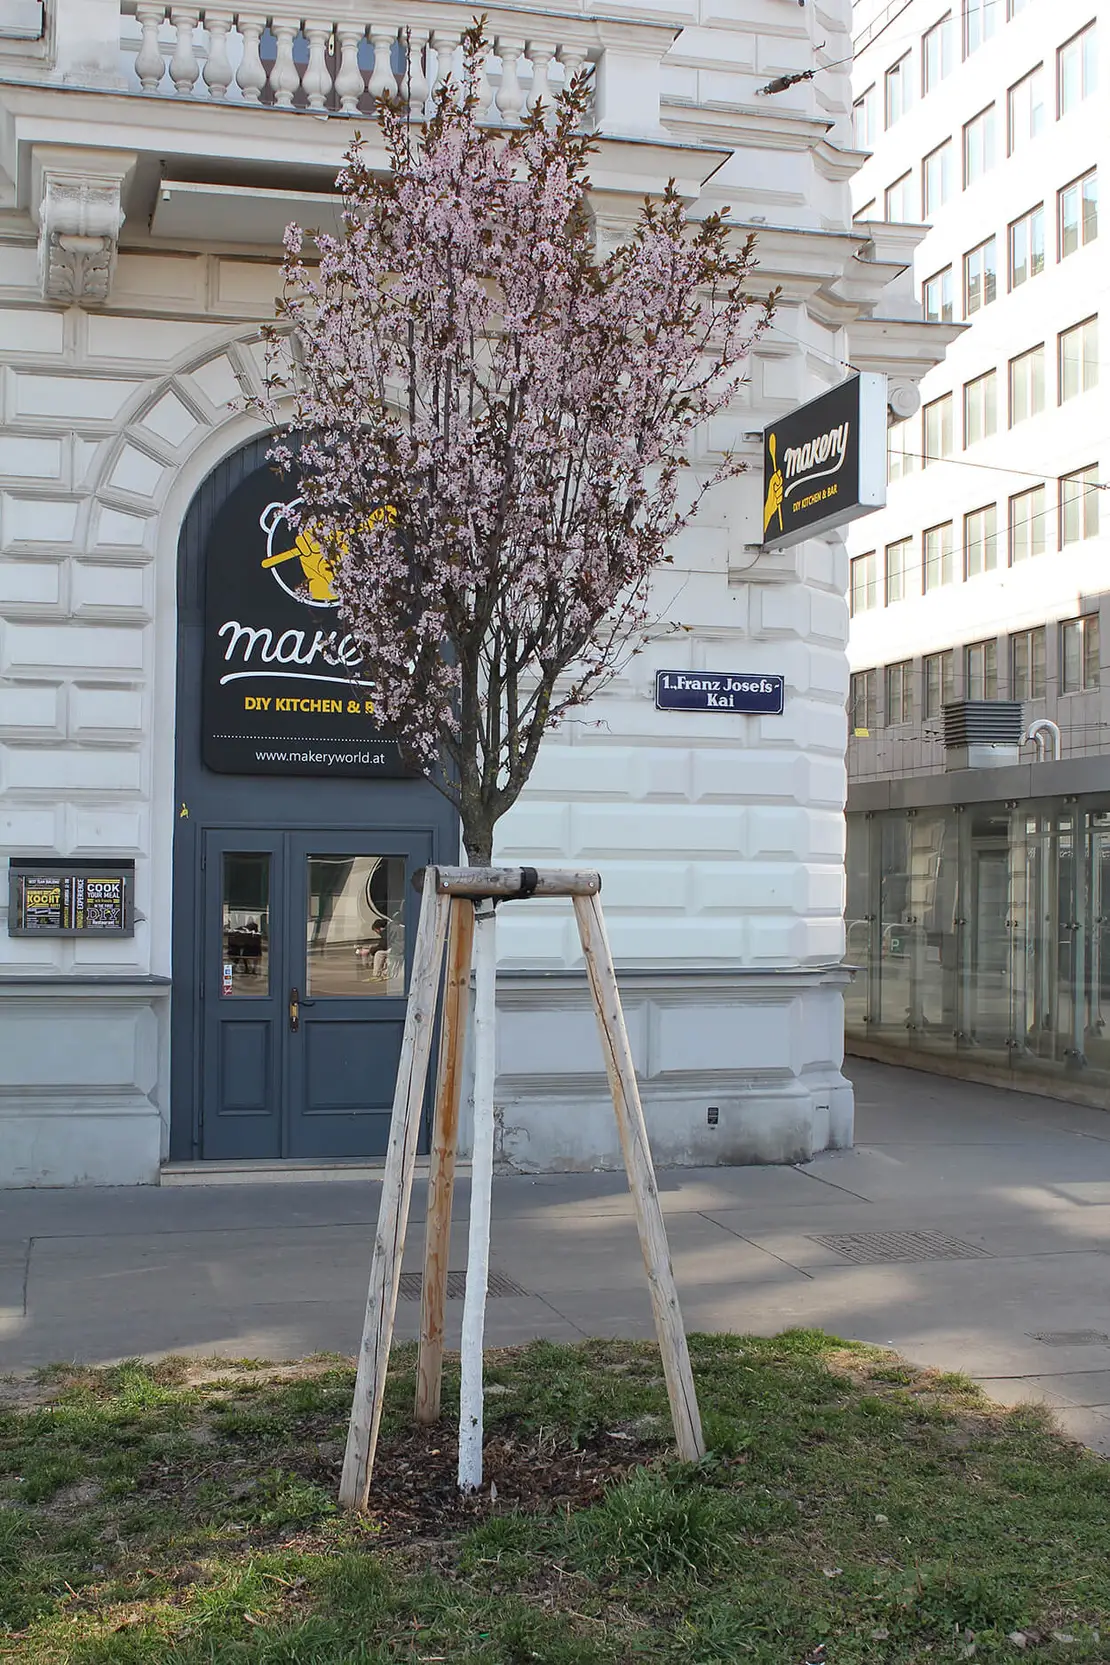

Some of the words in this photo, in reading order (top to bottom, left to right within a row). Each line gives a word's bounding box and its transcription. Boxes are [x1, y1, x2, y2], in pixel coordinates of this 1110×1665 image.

[784, 421, 849, 479] makery
[793, 501, 801, 513] DIY
[801, 491, 822, 509] KITCHEN
[822, 489, 827, 500] &
[827, 483, 838, 497] BAR
[218, 620, 364, 667] make
[244, 697, 271, 711] DIY
[275, 698, 342, 713] KITCHEN
[347, 701, 360, 713] &
[706, 693, 734, 707] Kai
[255, 750, 385, 765] www.makeryworld.at
[87, 884, 120, 892] COOK
[87, 908, 120, 920] DIY
